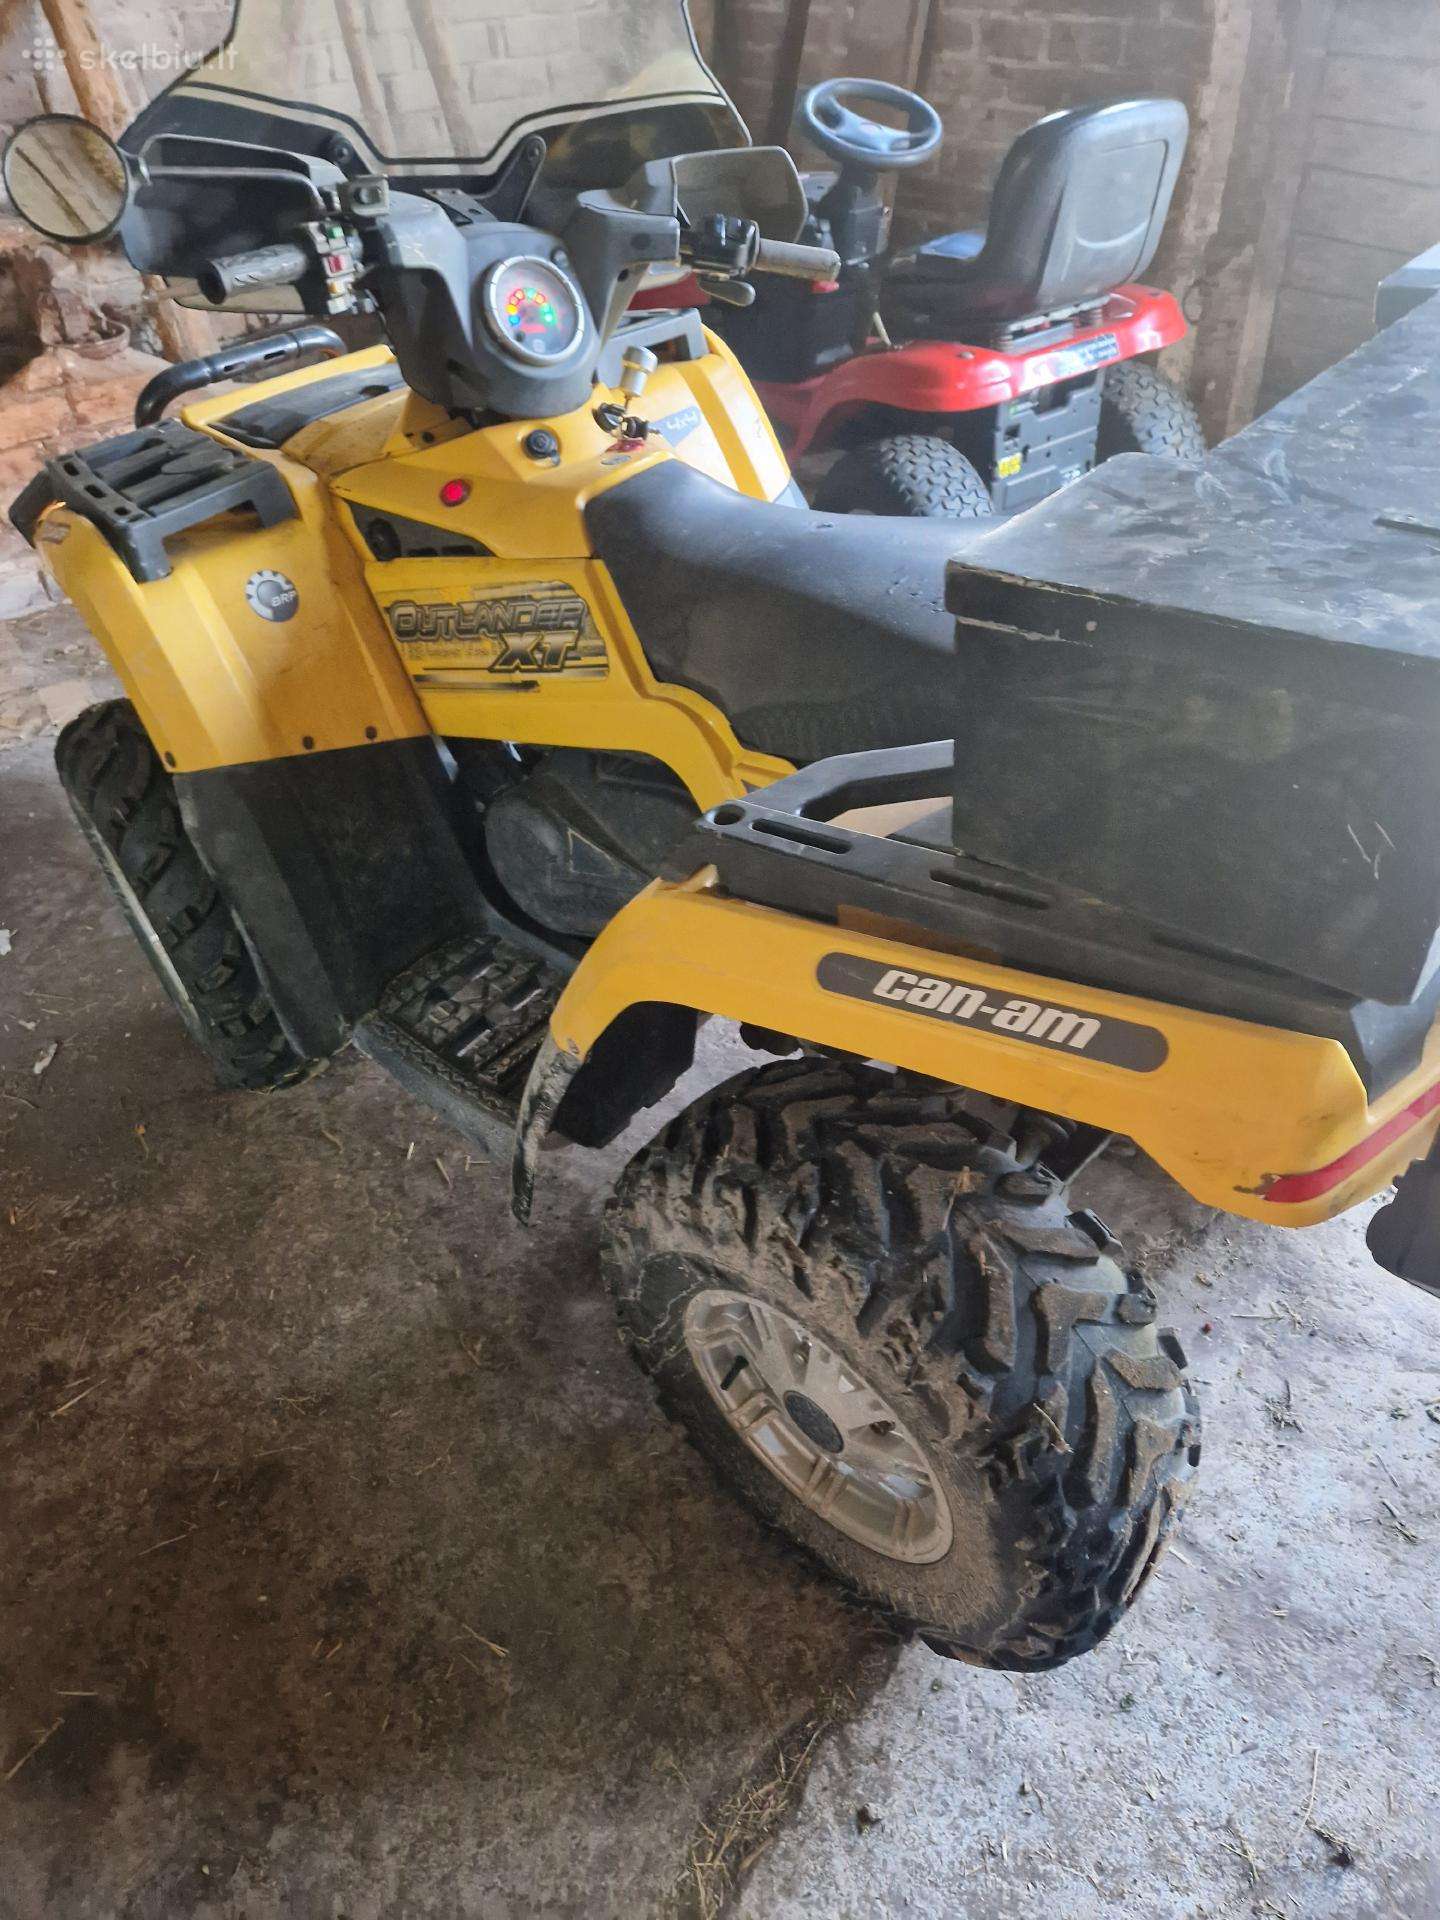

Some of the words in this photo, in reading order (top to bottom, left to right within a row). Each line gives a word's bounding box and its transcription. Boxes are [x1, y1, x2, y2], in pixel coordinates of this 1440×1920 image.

[271, 591, 296, 607] BRP
[389, 600, 585, 642] OUTLANDER
[488, 629, 579, 673] XT
[873, 969, 1102, 1050] can-am
